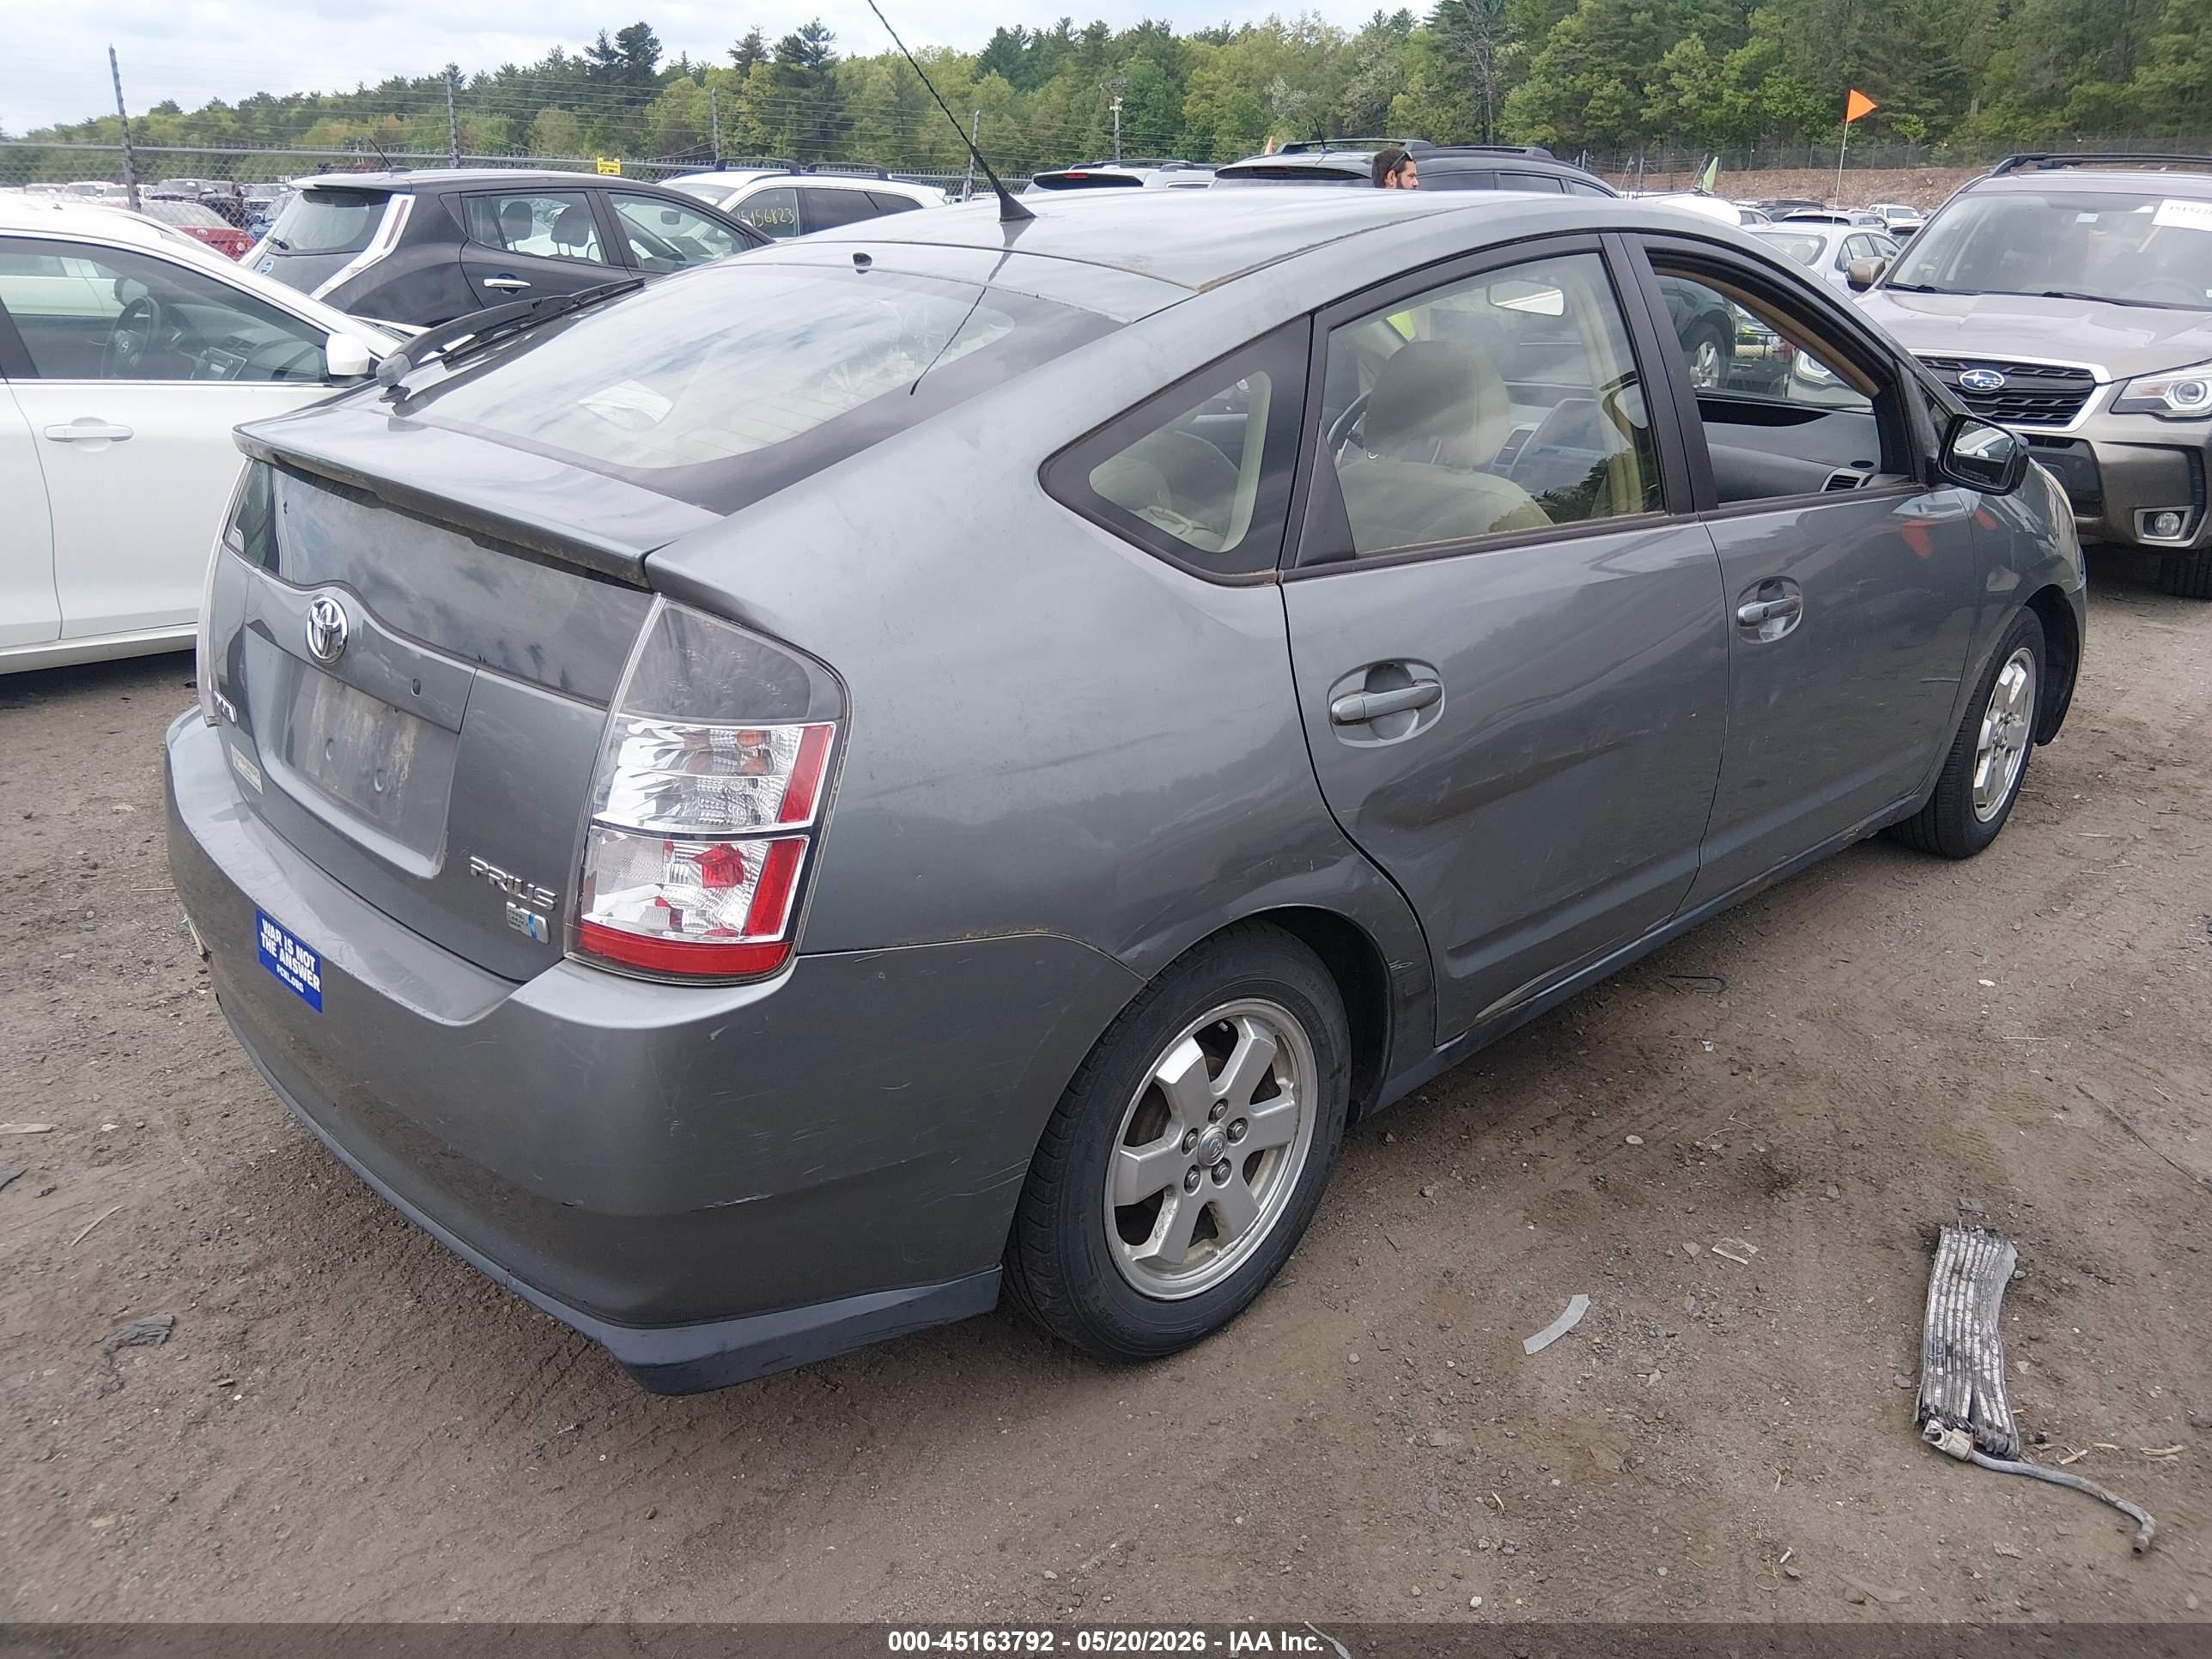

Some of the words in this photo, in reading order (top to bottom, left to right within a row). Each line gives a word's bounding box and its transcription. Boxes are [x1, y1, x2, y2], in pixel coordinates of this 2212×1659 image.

[470, 854, 558, 911] PRIUS
[260, 932, 277, 958] THE
[279, 947, 321, 993] ANSWER
[261, 918, 283, 947] WAR
[283, 935, 295, 956] IS
[295, 944, 316, 973] NOT
